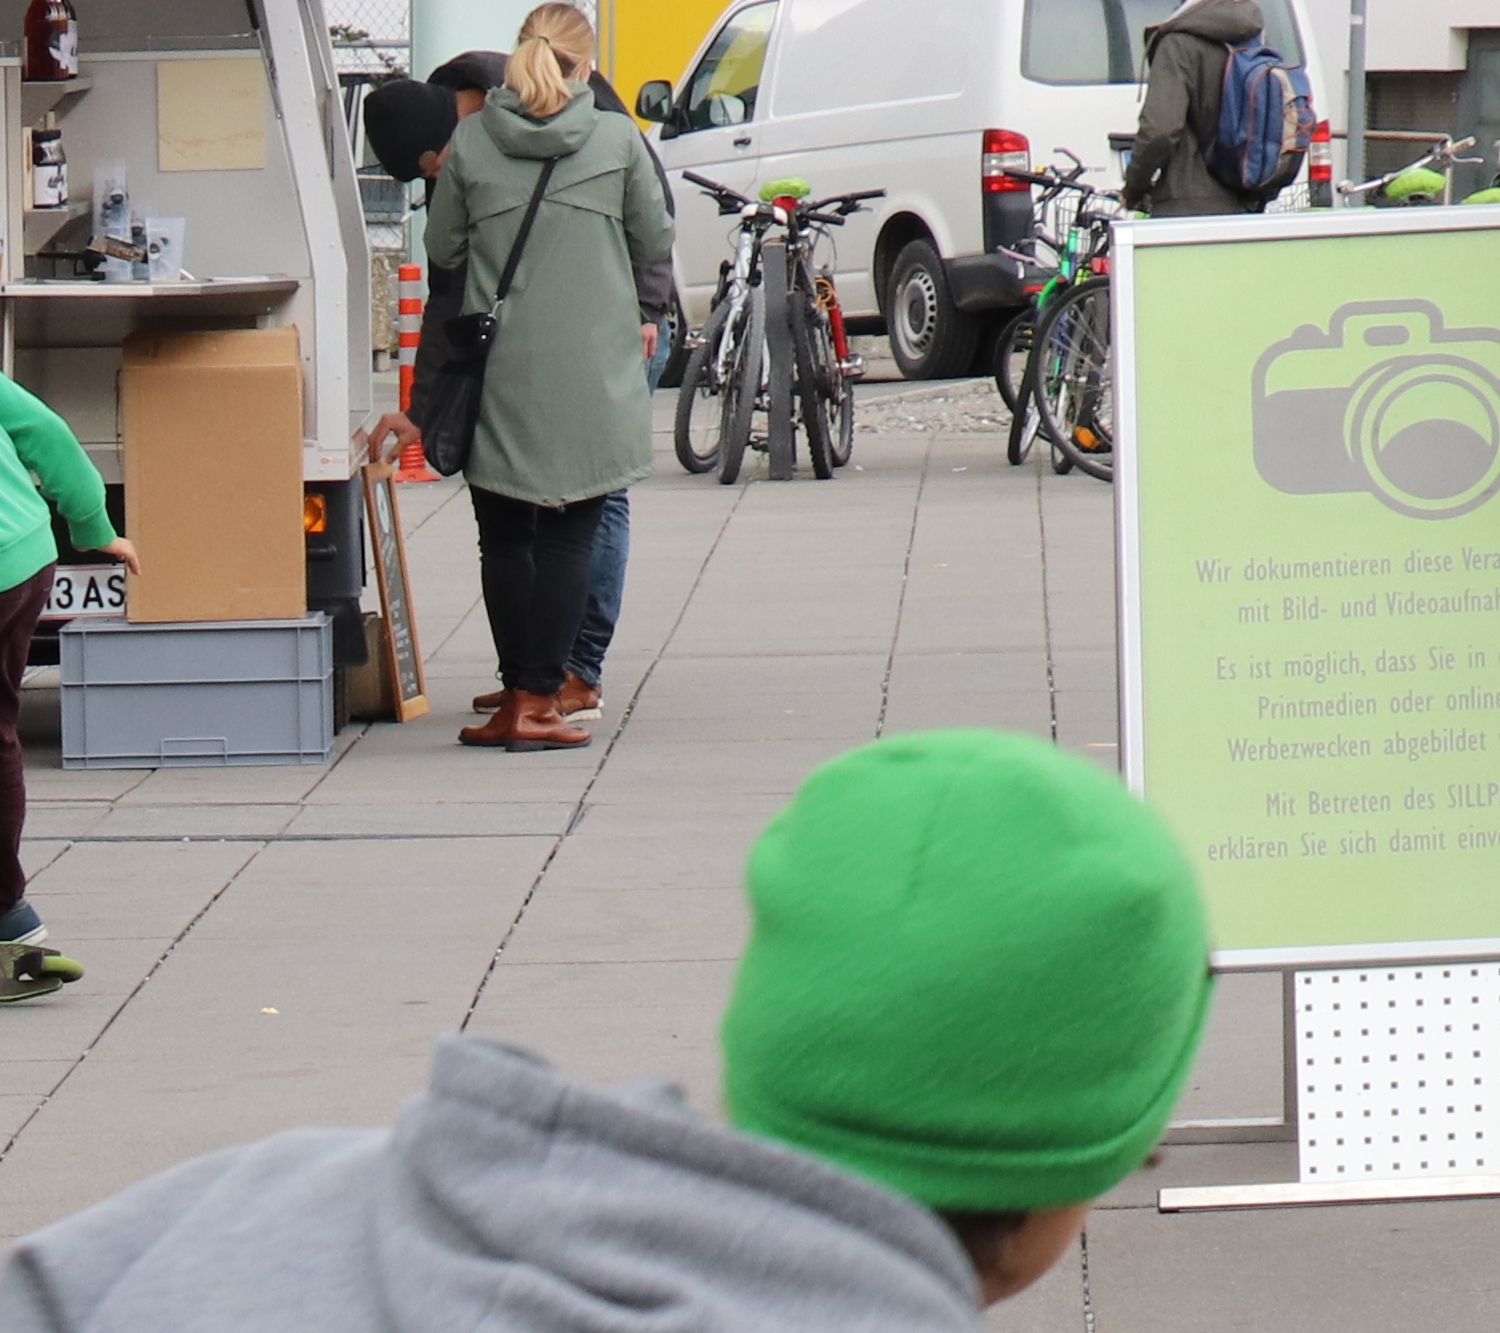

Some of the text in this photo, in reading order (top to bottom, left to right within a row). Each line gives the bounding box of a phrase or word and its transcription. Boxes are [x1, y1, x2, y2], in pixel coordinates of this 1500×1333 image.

[1196, 559, 1232, 583] Wir
[1243, 552, 1392, 582] dokumentieren
[1405, 550, 1454, 573] diese
[46, 575, 125, 610] 3 AS
[1238, 600, 1270, 623] mit
[1283, 595, 1328, 621] Bild-
[1341, 594, 1377, 617] und
[1216, 657, 1237, 680] Es
[1249, 654, 1272, 678] ist
[1284, 650, 1366, 681] möglich,
[1376, 648, 1417, 673] dass
[1429, 645, 1456, 670] Sie
[1468, 643, 1486, 668] in
[1258, 691, 1377, 719] Printmedien
[1390, 690, 1434, 713] oder
[1228, 735, 1371, 762] Werbezwecken
[1384, 728, 1487, 760] abgebildet
[1266, 793, 1296, 817] Mit
[1309, 790, 1391, 814] Betreten
[1404, 786, 1436, 810] des
[1207, 836, 1289, 861] erklären
[1301, 832, 1327, 855] Sie
[1340, 829, 1377, 854] sich
[1389, 826, 1446, 851] damit
